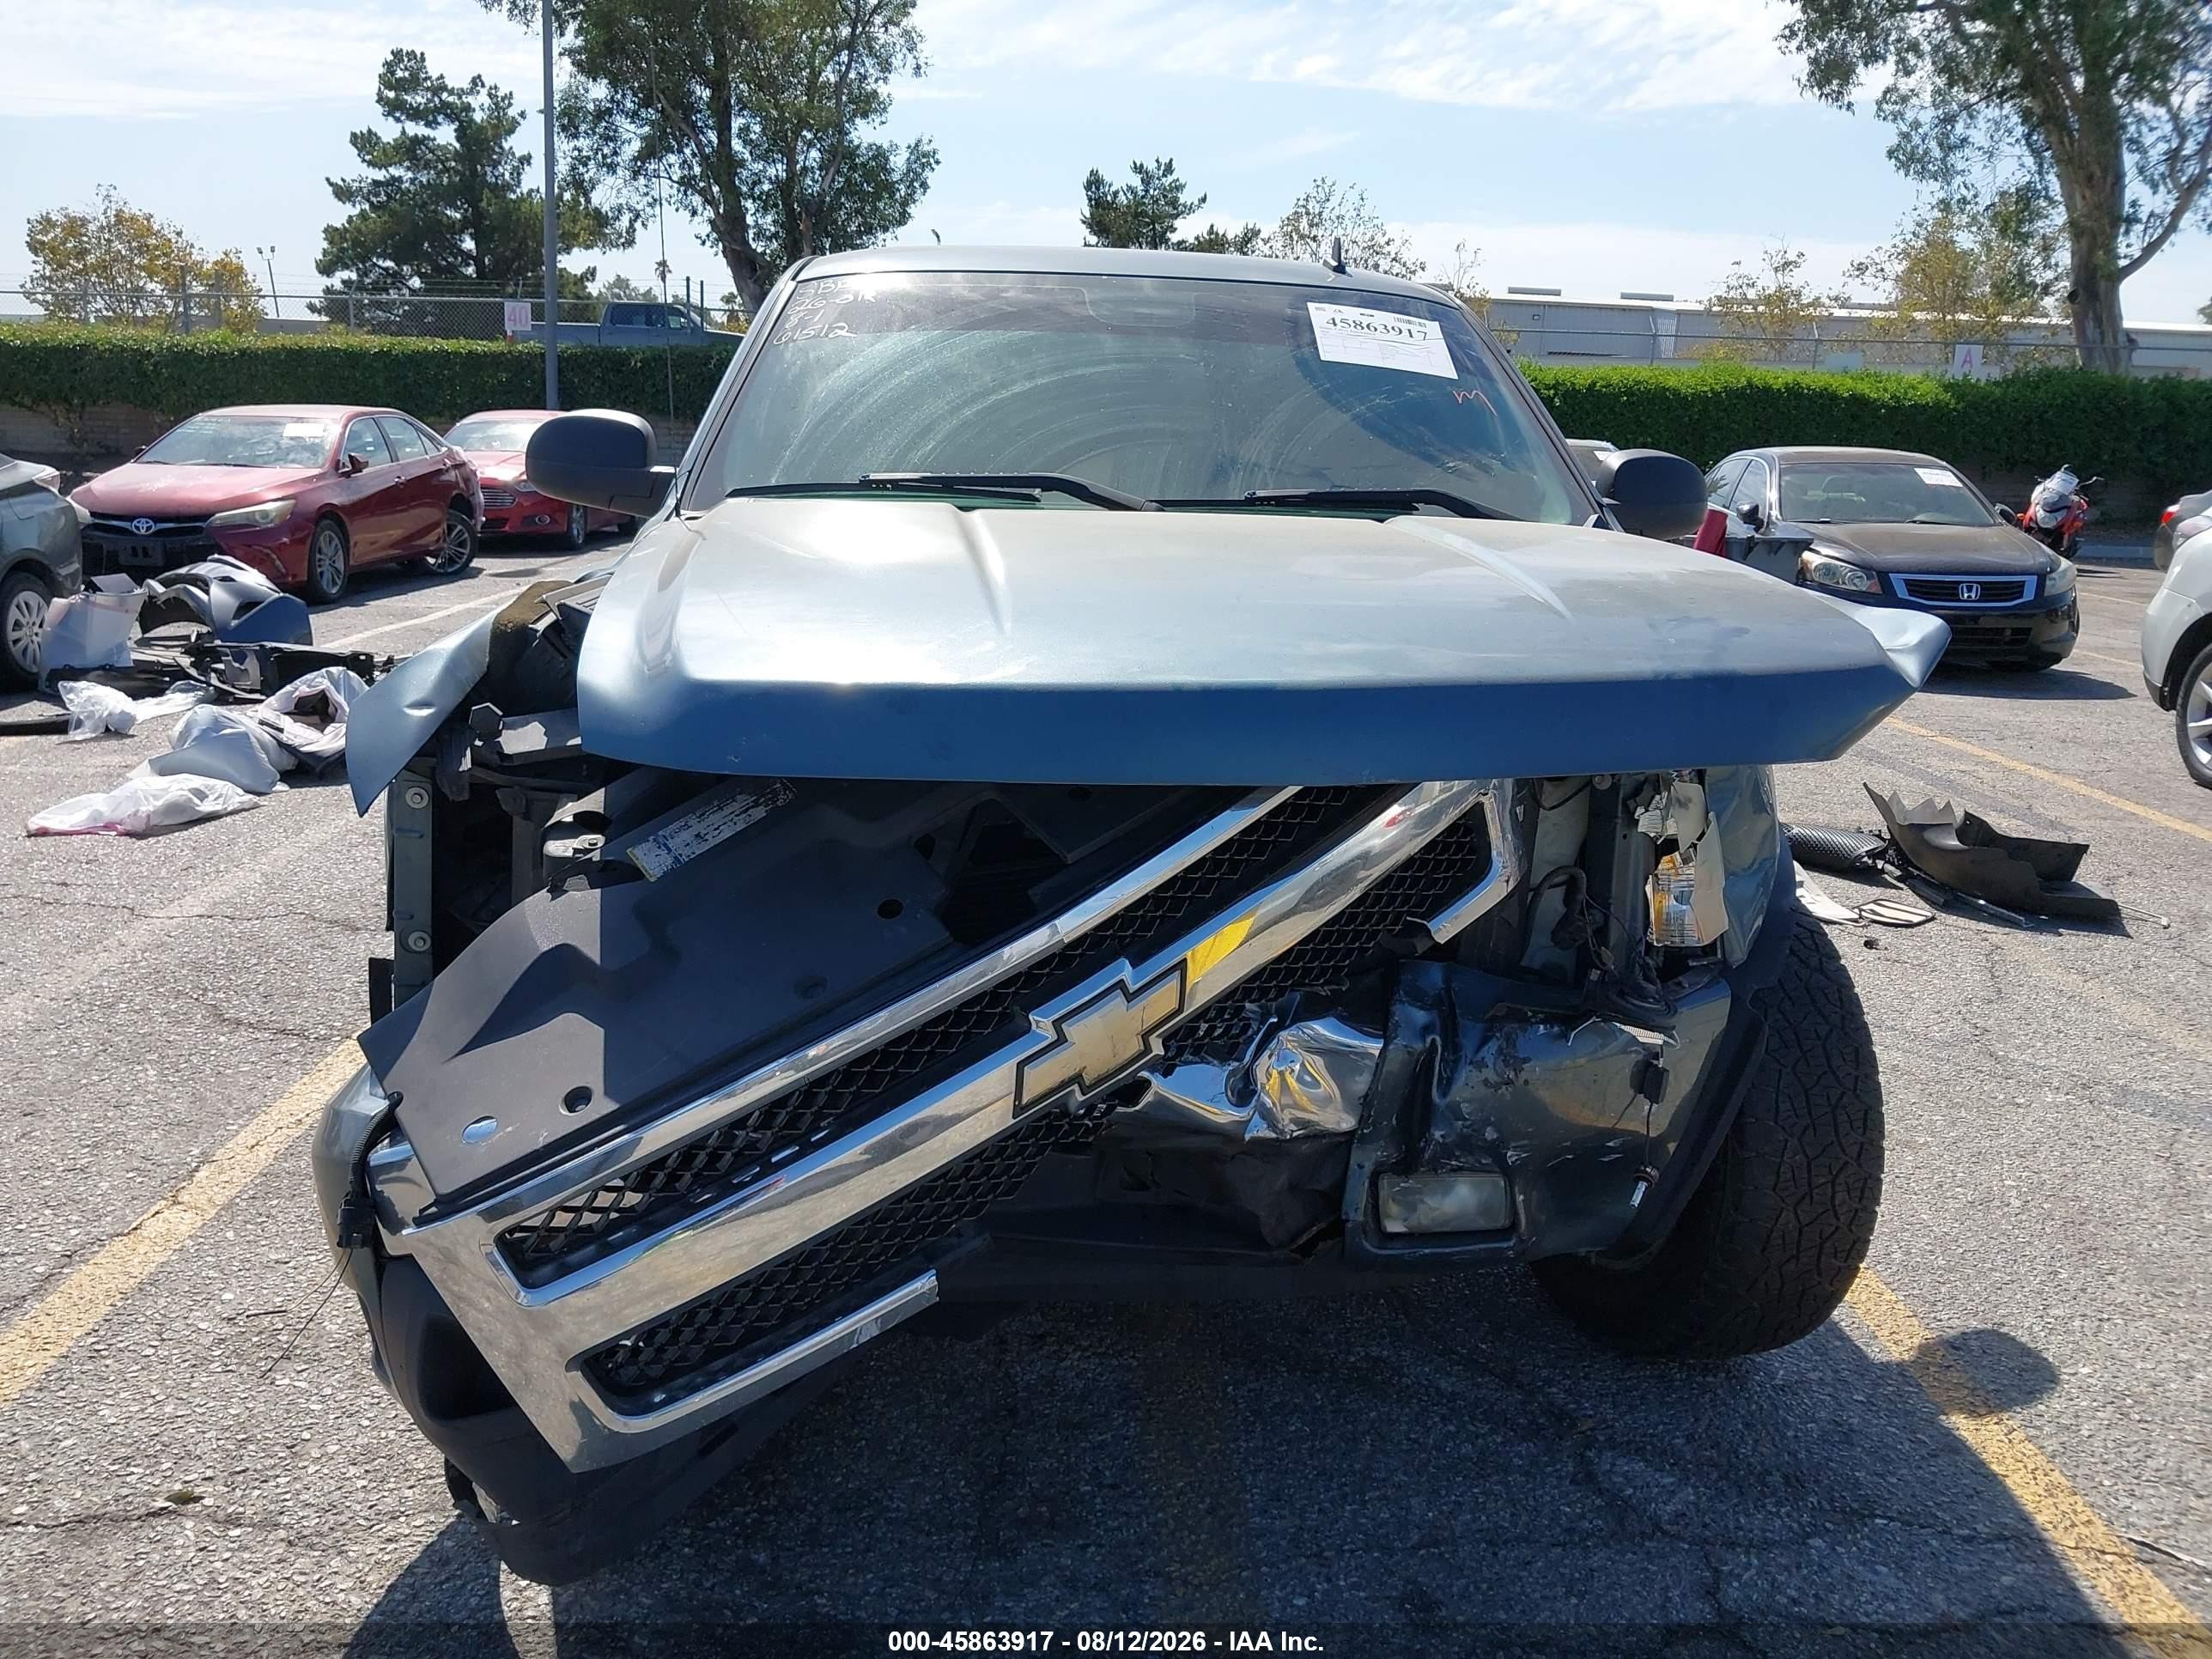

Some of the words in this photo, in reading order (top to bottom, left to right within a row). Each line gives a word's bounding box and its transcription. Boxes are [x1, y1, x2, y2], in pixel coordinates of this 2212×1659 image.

[507, 306, 529, 328] 40
[1325, 316, 1429, 341] 45863917
[1960, 347, 1974, 369] A
